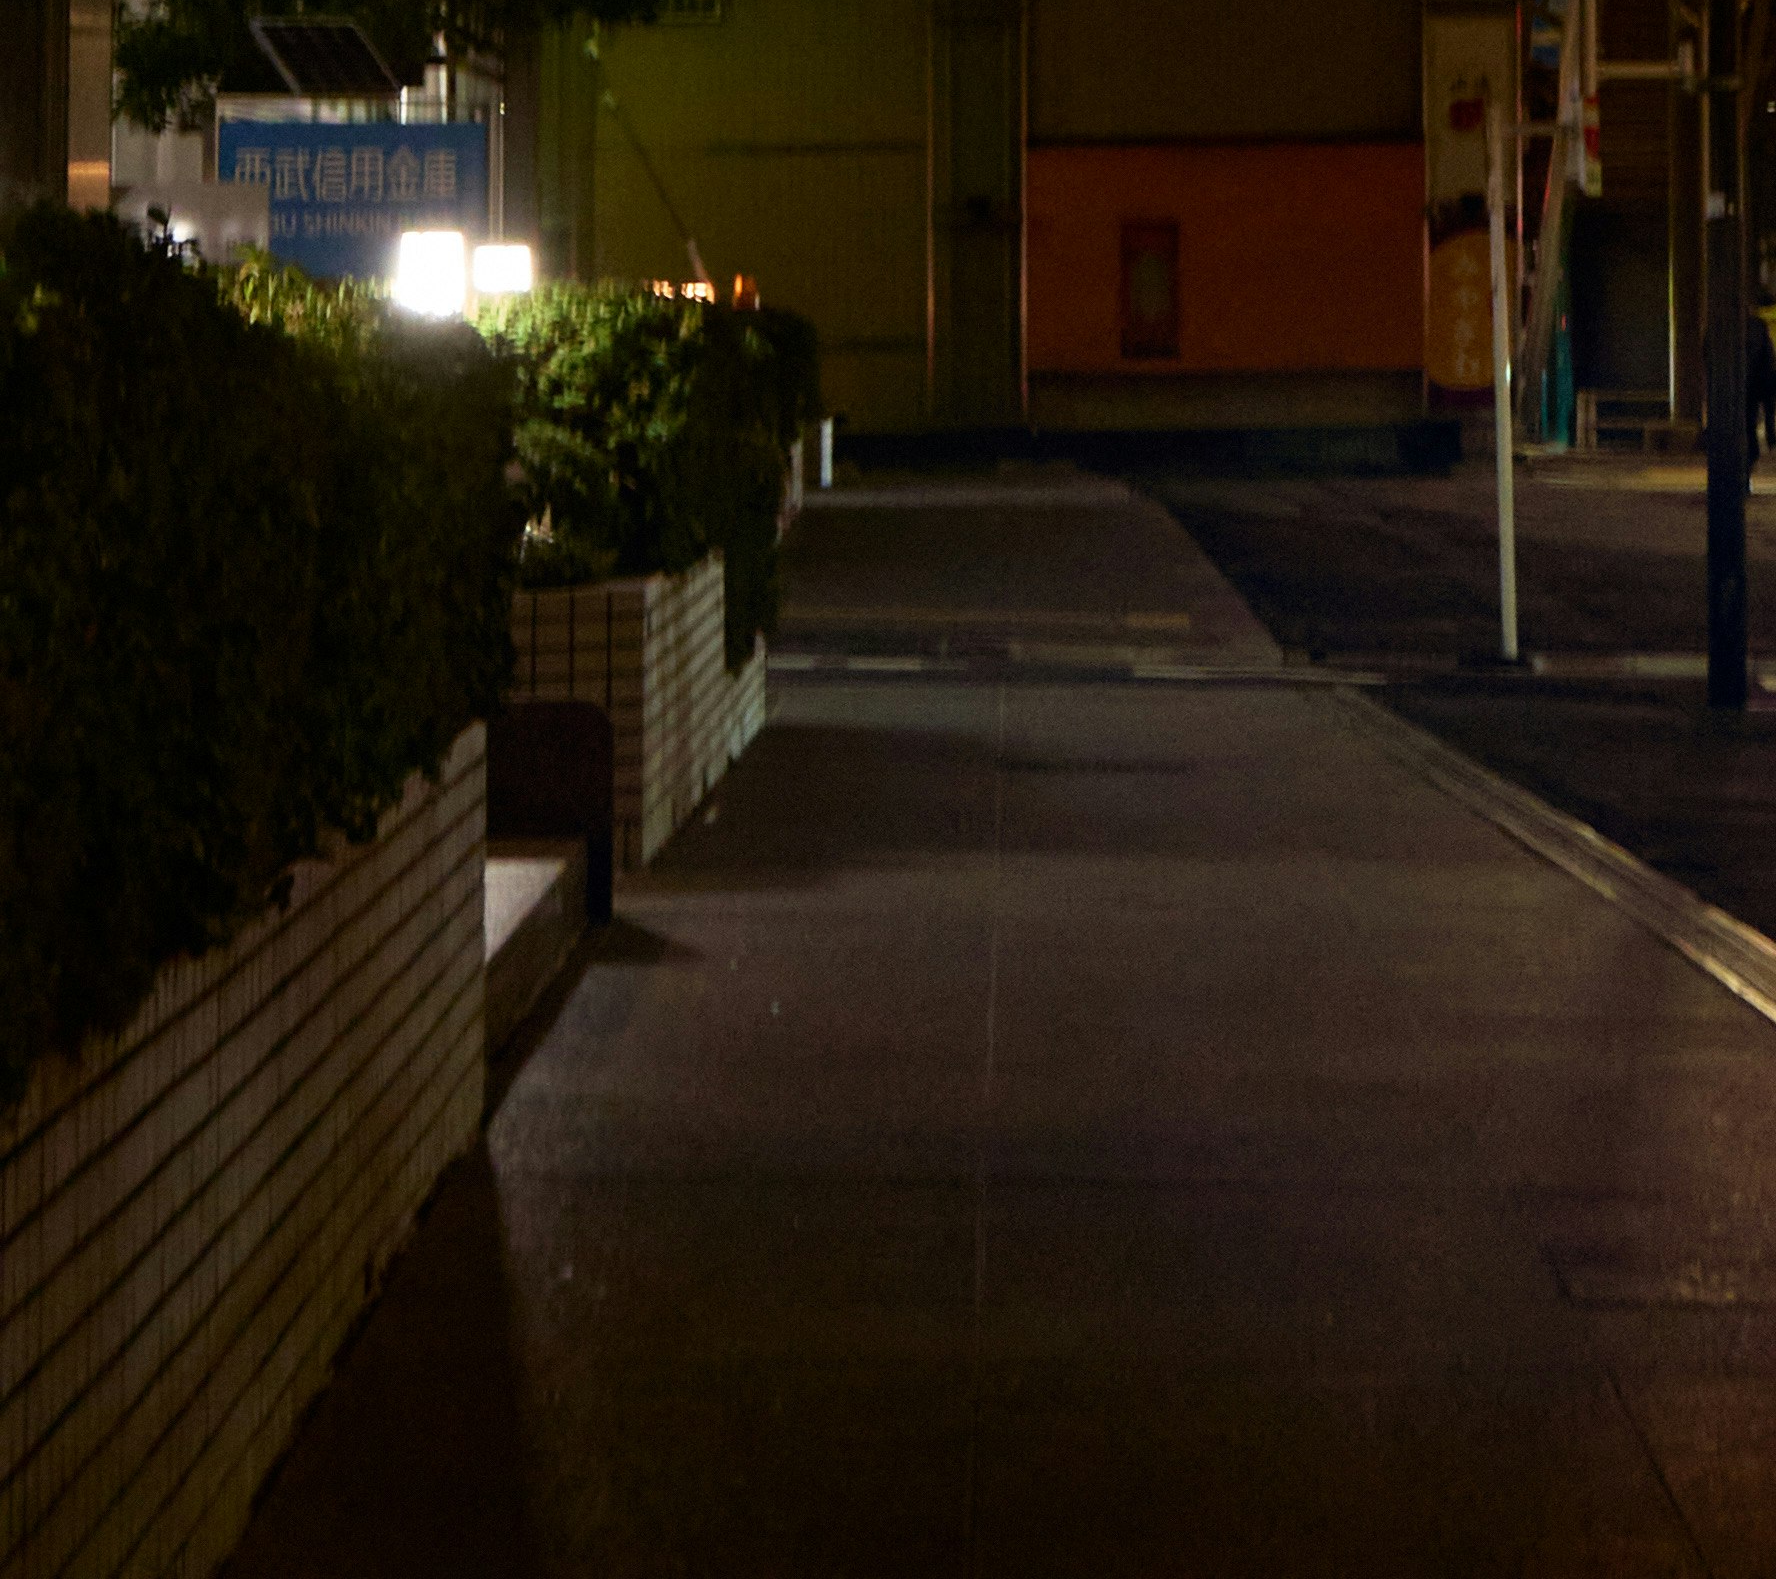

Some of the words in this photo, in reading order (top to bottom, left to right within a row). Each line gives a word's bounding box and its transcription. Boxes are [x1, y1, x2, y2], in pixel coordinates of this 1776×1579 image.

[234, 145, 458, 202] 西武信用金庫
